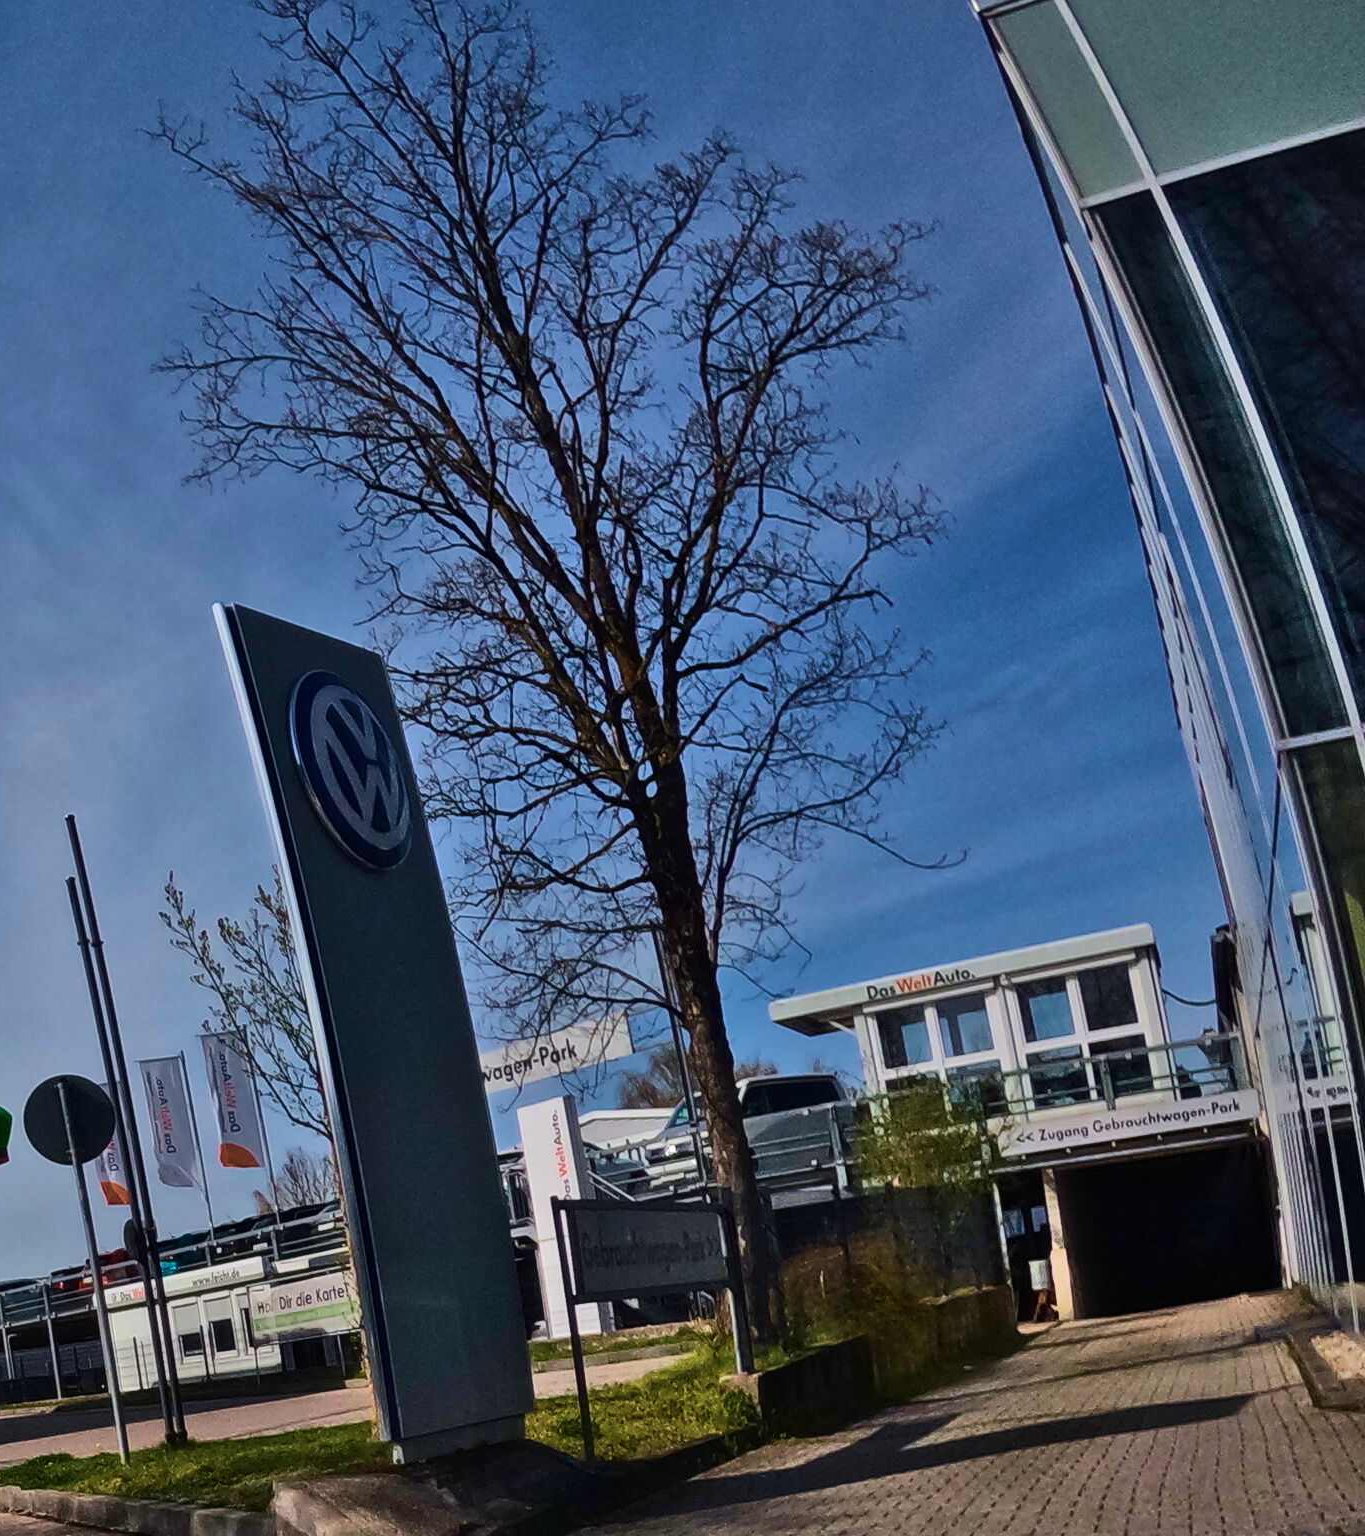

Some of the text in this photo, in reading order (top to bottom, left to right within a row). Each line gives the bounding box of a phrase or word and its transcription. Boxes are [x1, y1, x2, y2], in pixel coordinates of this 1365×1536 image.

[866, 984, 896, 1000] Das
[1038, 1125, 1089, 1142] Zugang
[1092, 1098, 1241, 1132] Gebrauchtwagen-Park
[279, 1294, 292, 1310] Dir
[295, 1291, 312, 1307] die
